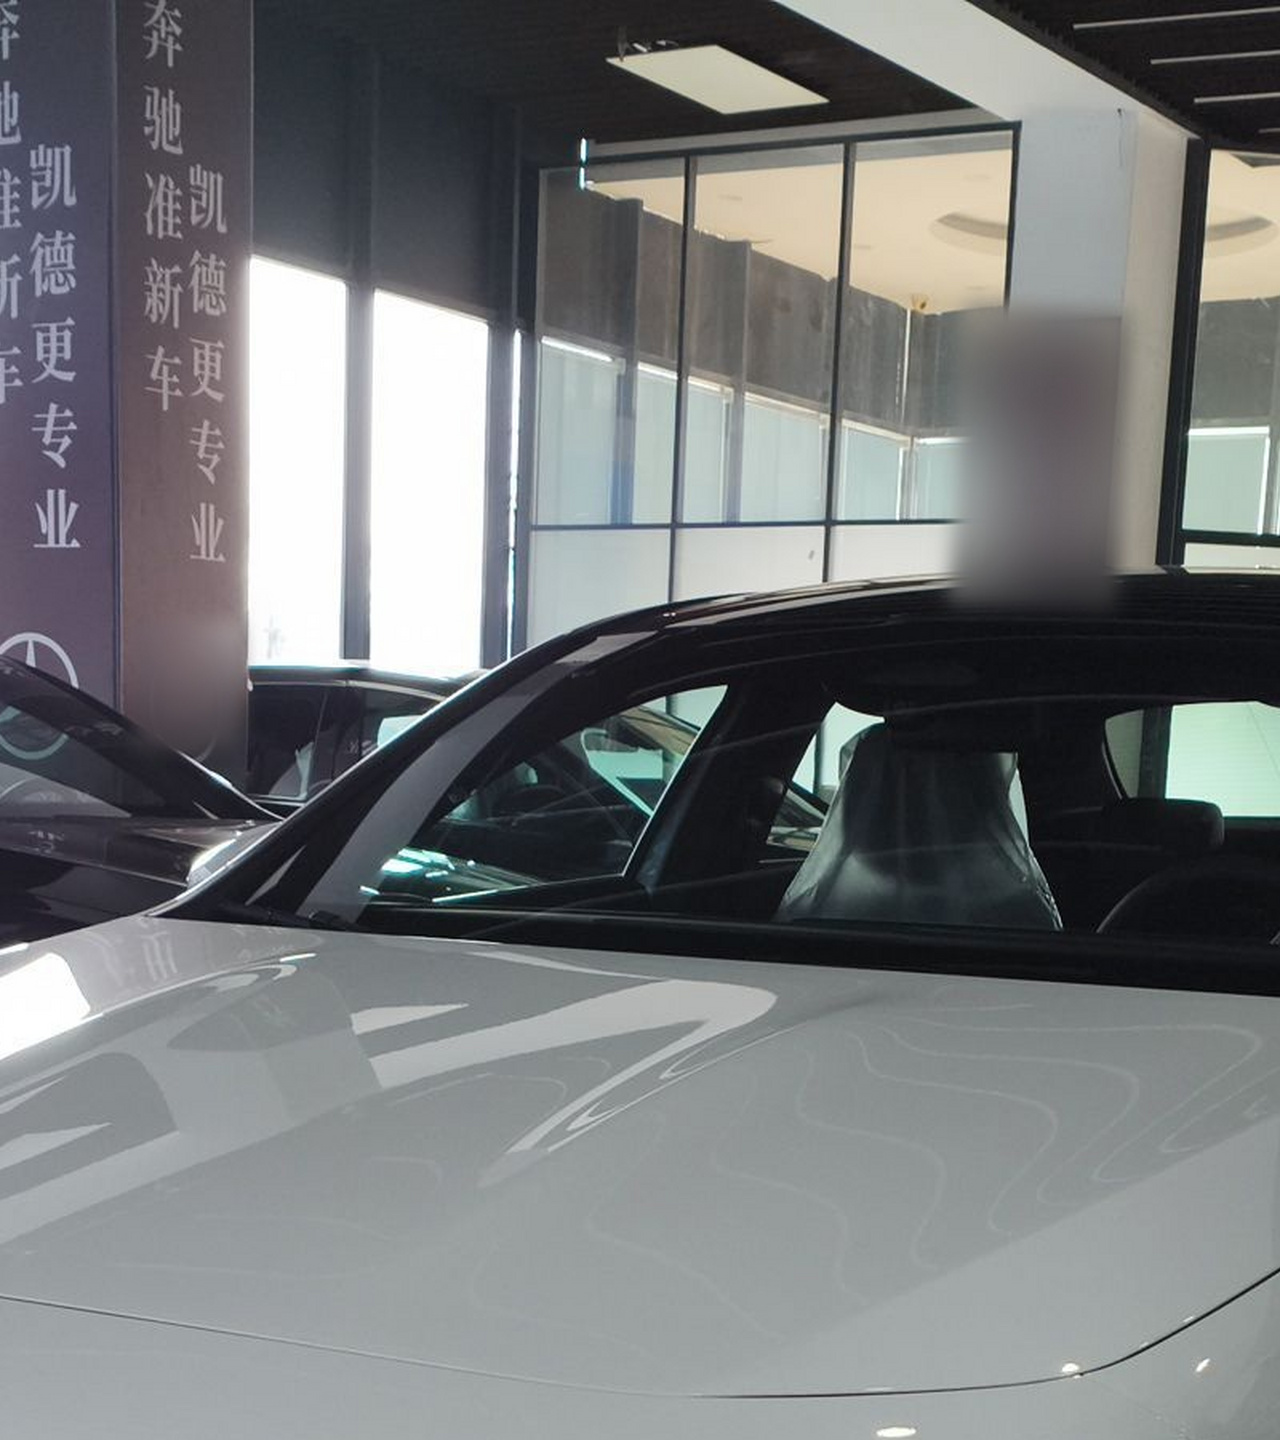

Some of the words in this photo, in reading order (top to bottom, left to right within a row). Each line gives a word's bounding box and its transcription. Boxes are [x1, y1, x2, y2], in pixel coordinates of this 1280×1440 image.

[29, 144, 81, 549] 凯德更专业
[142, 0, 184, 411] 奔驰准新车
[188, 163, 227, 563] 凯德更专业
